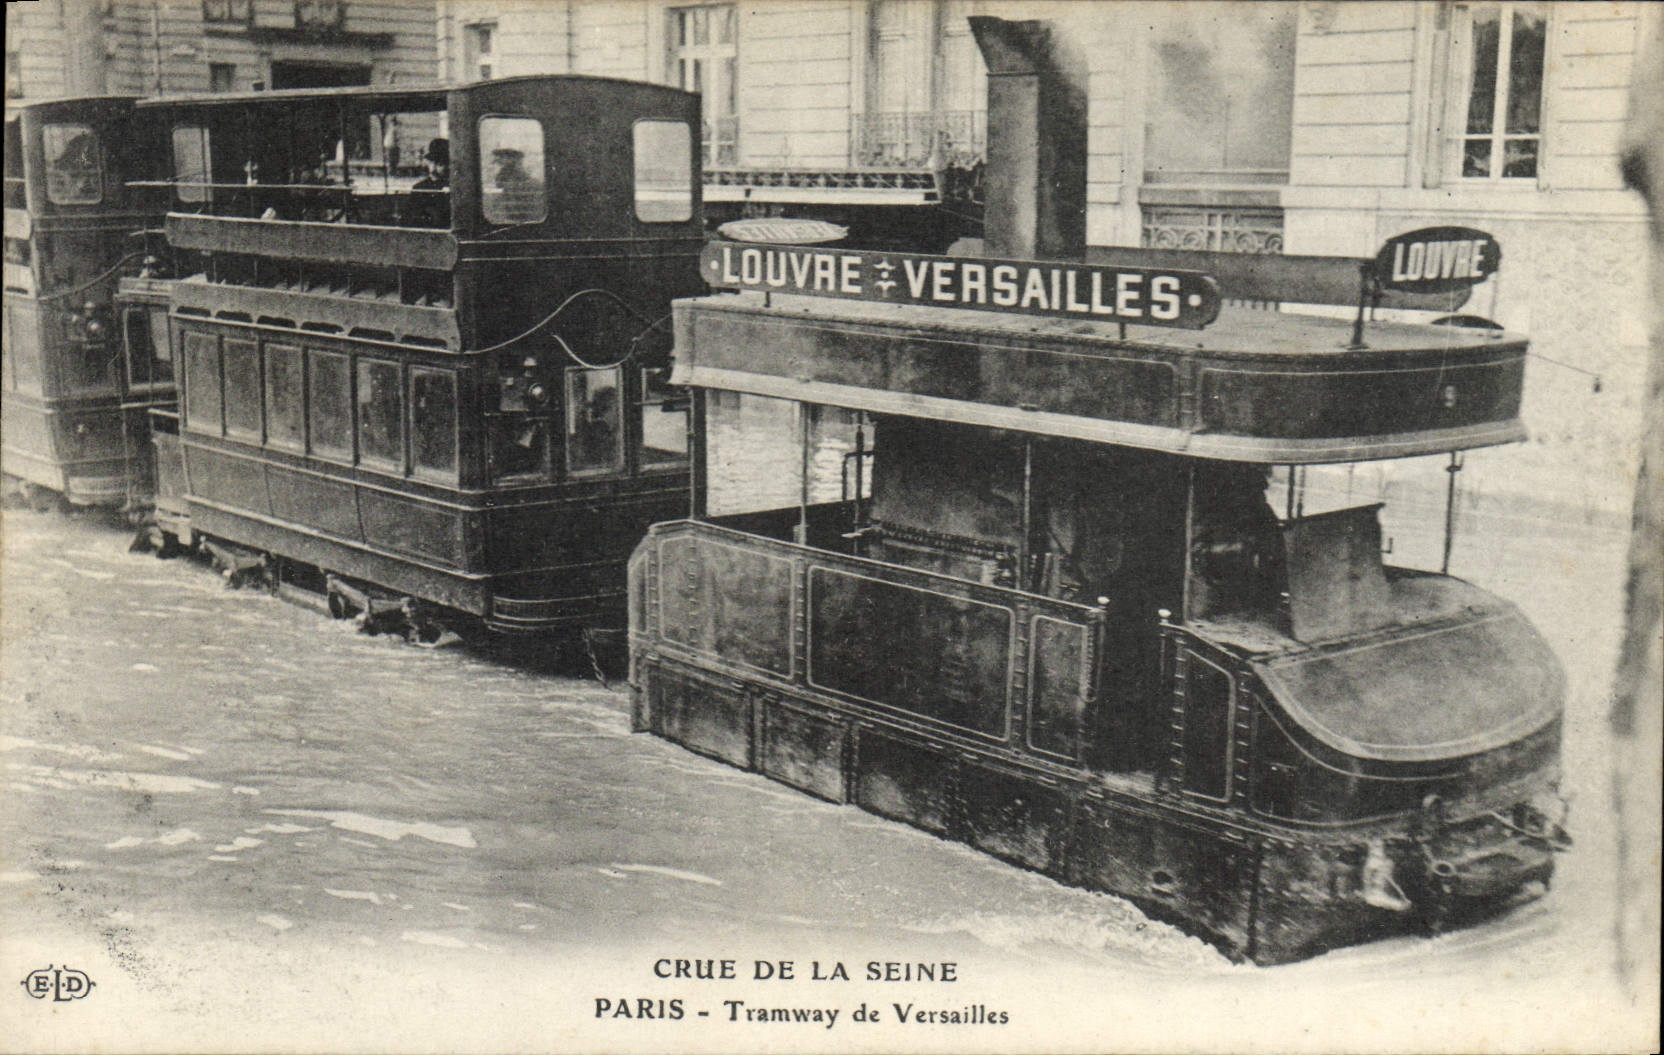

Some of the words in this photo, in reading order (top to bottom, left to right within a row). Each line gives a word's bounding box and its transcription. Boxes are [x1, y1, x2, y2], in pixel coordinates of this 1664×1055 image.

[722, 247, 863, 294] LOUVRE
[902, 255, 1181, 321] VERSAILLES
[1391, 239, 1488, 282] LOUVRE
